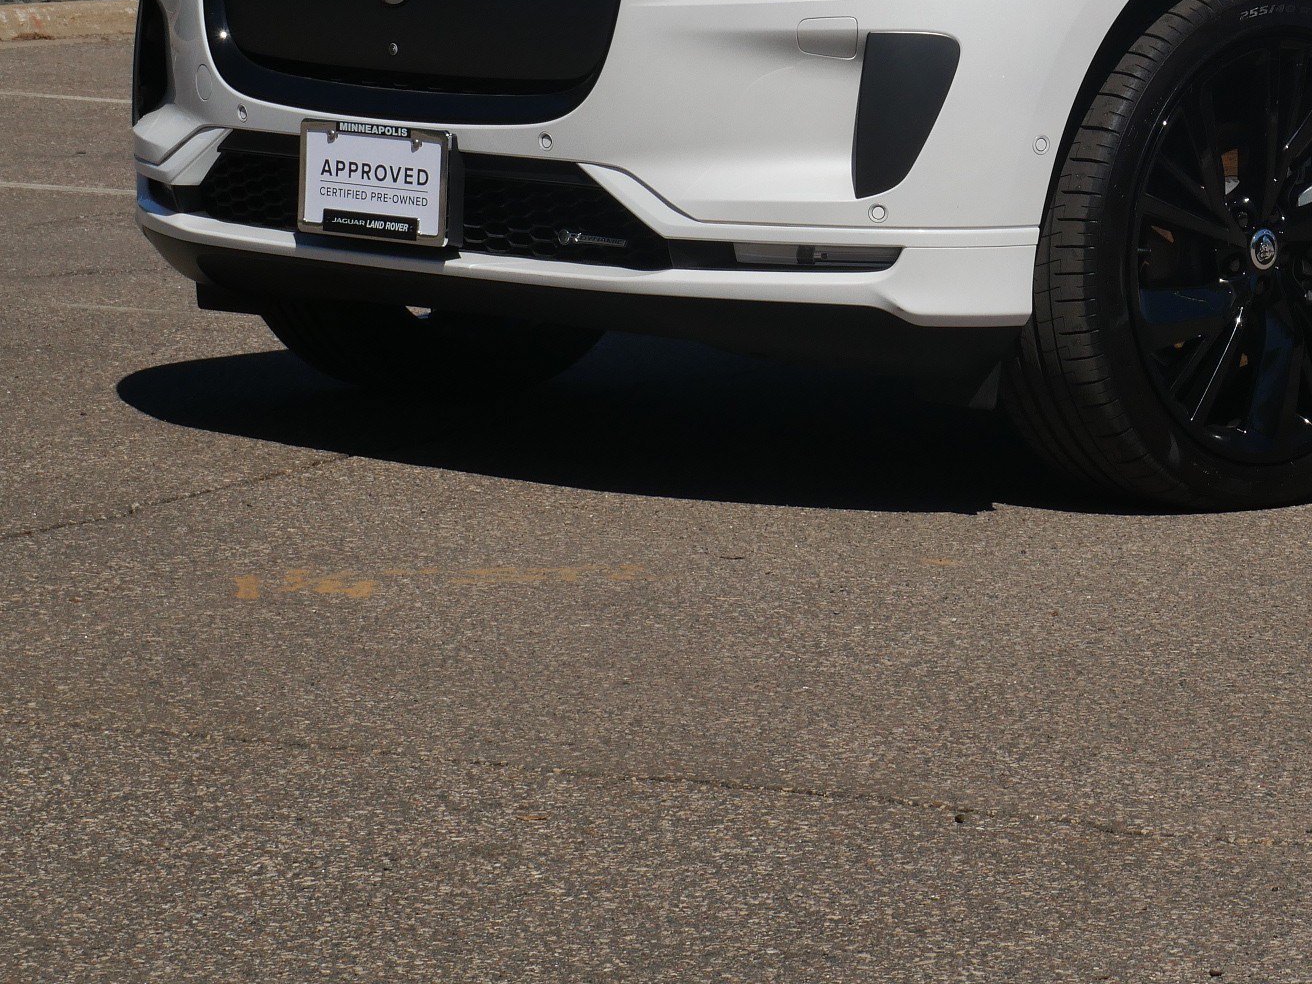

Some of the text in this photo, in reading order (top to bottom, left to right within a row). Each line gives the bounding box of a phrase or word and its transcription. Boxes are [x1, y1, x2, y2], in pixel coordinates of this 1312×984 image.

[339, 122, 408, 137] MINNEAPOLIS
[320, 159, 429, 186] APPROVED
[319, 186, 429, 207] CERTIFIED PRE-OWNED
[332, 217, 409, 232] JAGUAR LAND ROVER
